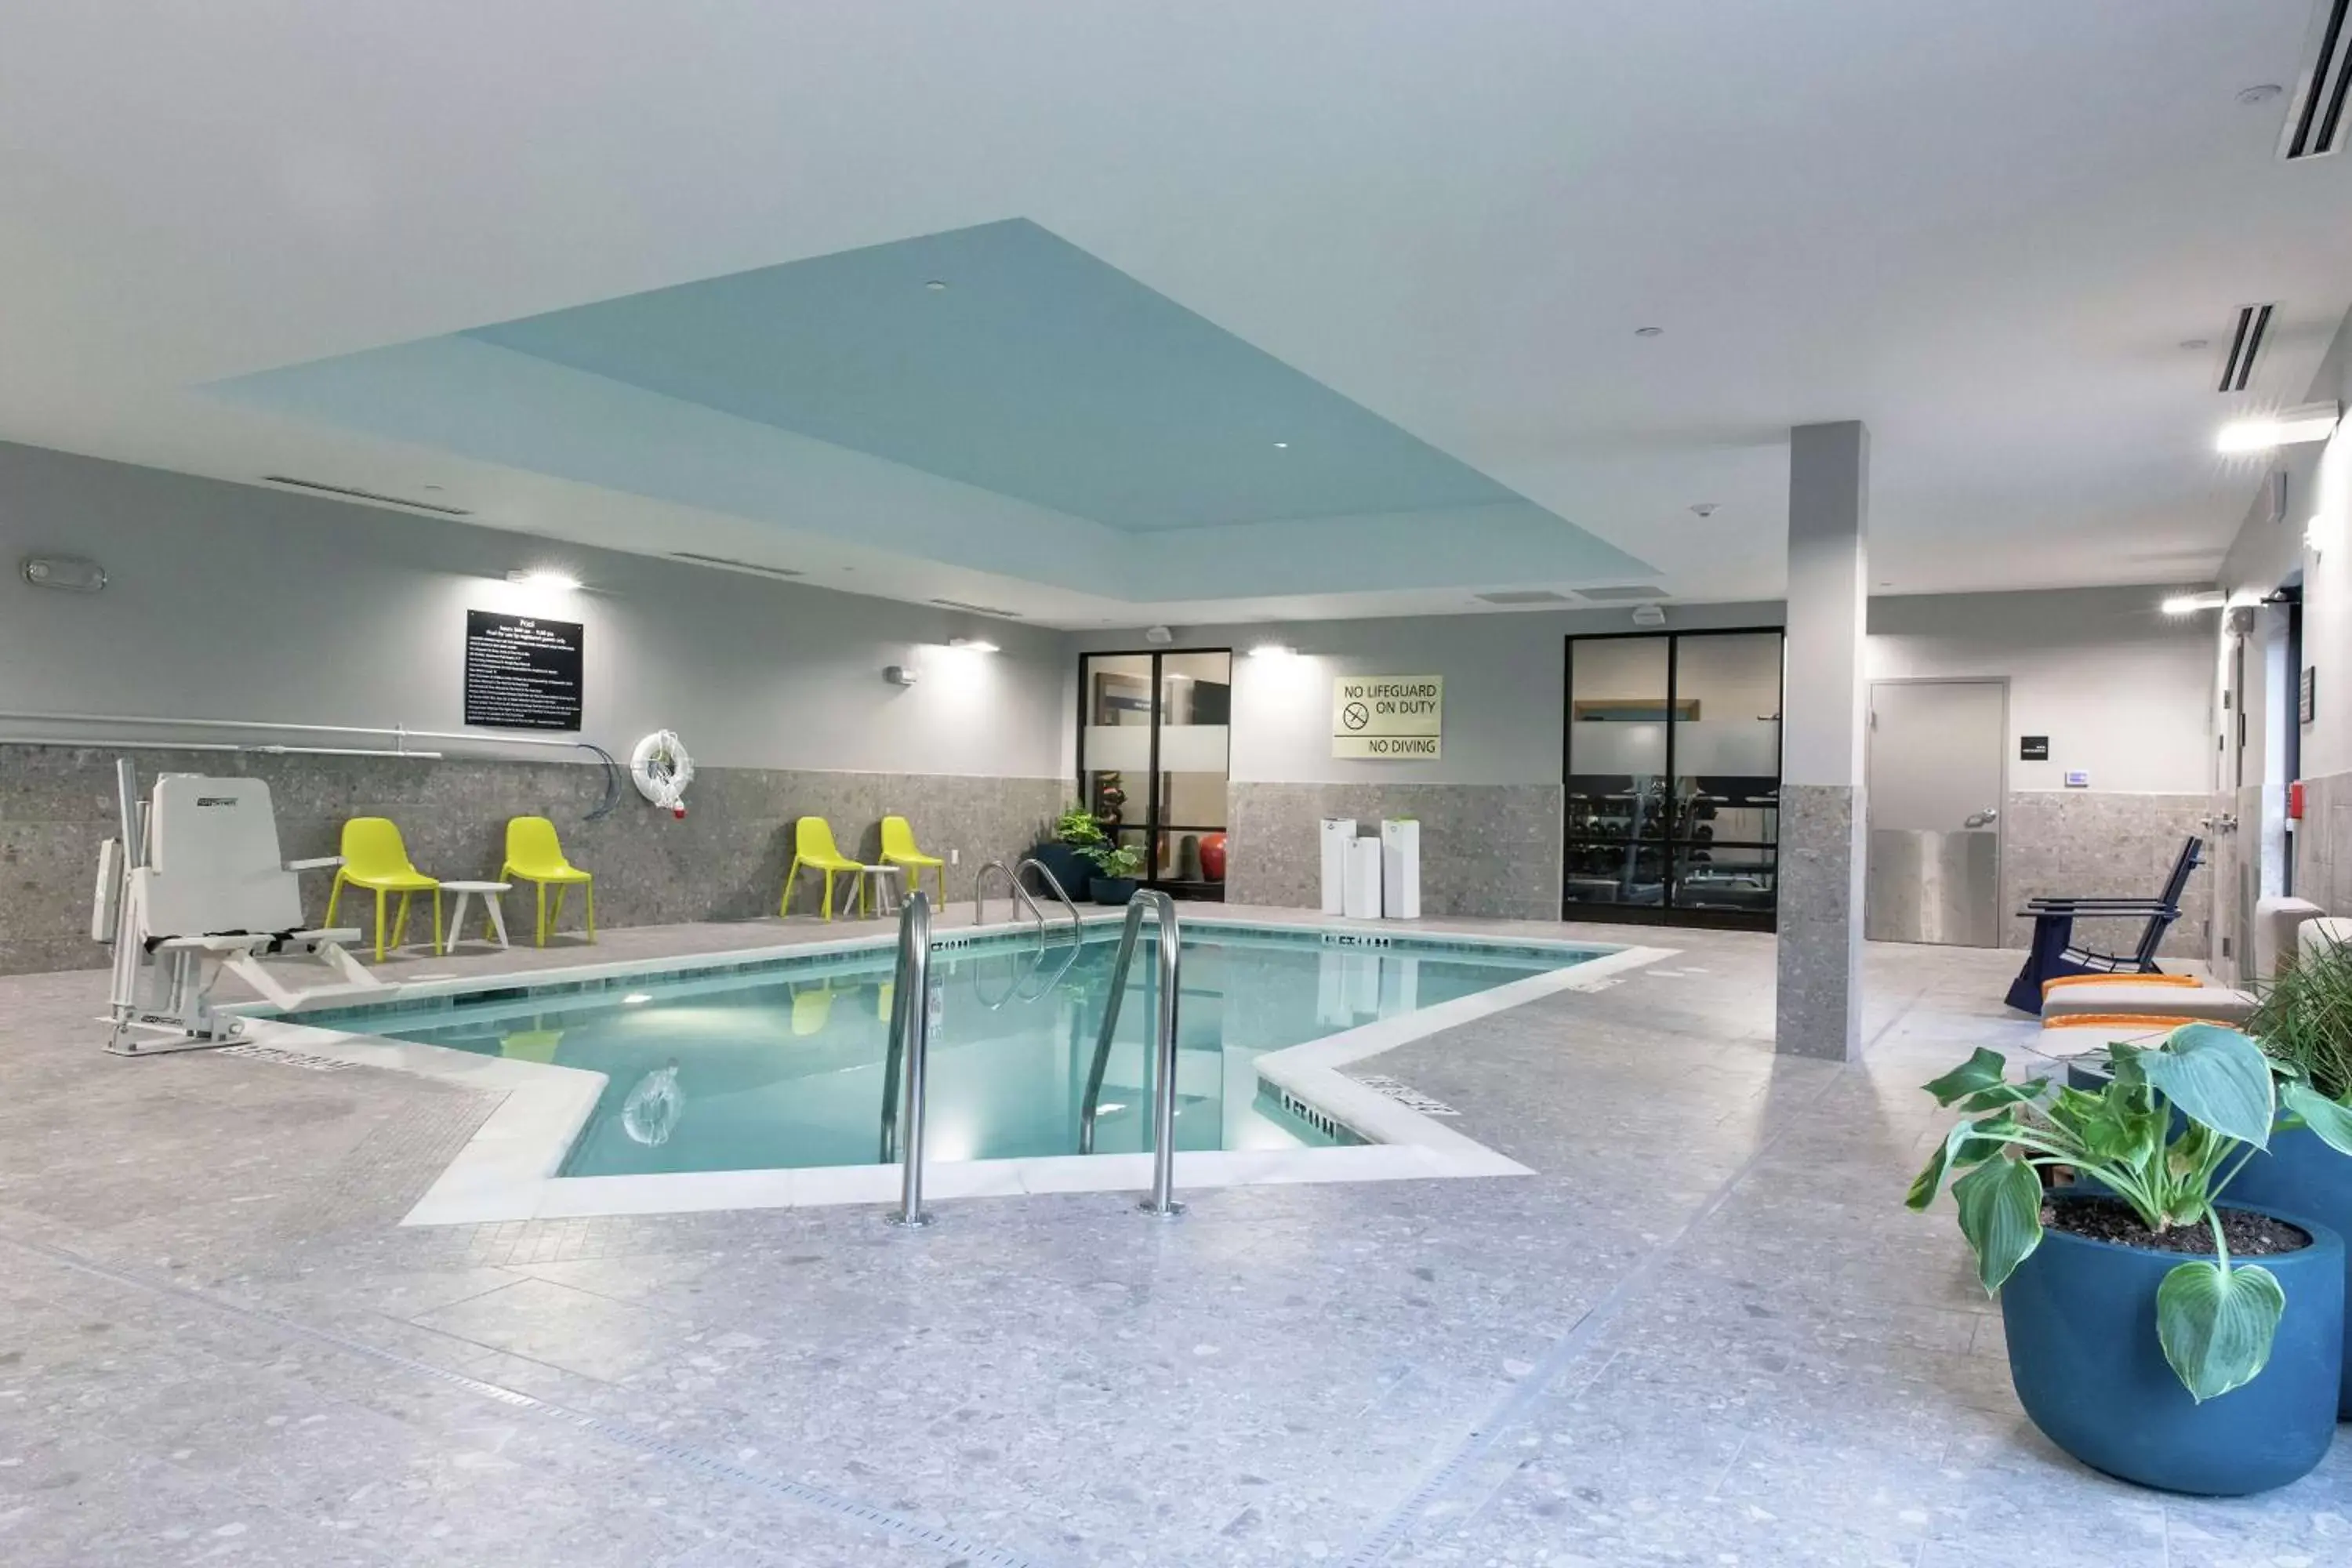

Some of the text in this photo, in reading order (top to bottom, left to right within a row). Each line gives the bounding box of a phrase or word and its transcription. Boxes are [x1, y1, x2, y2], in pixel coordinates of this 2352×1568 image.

[1345, 684, 1437, 698] NO LIFEGUARD
[1376, 699, 1436, 714] ON DUTY
[1369, 739, 1436, 753] NO DIVING
